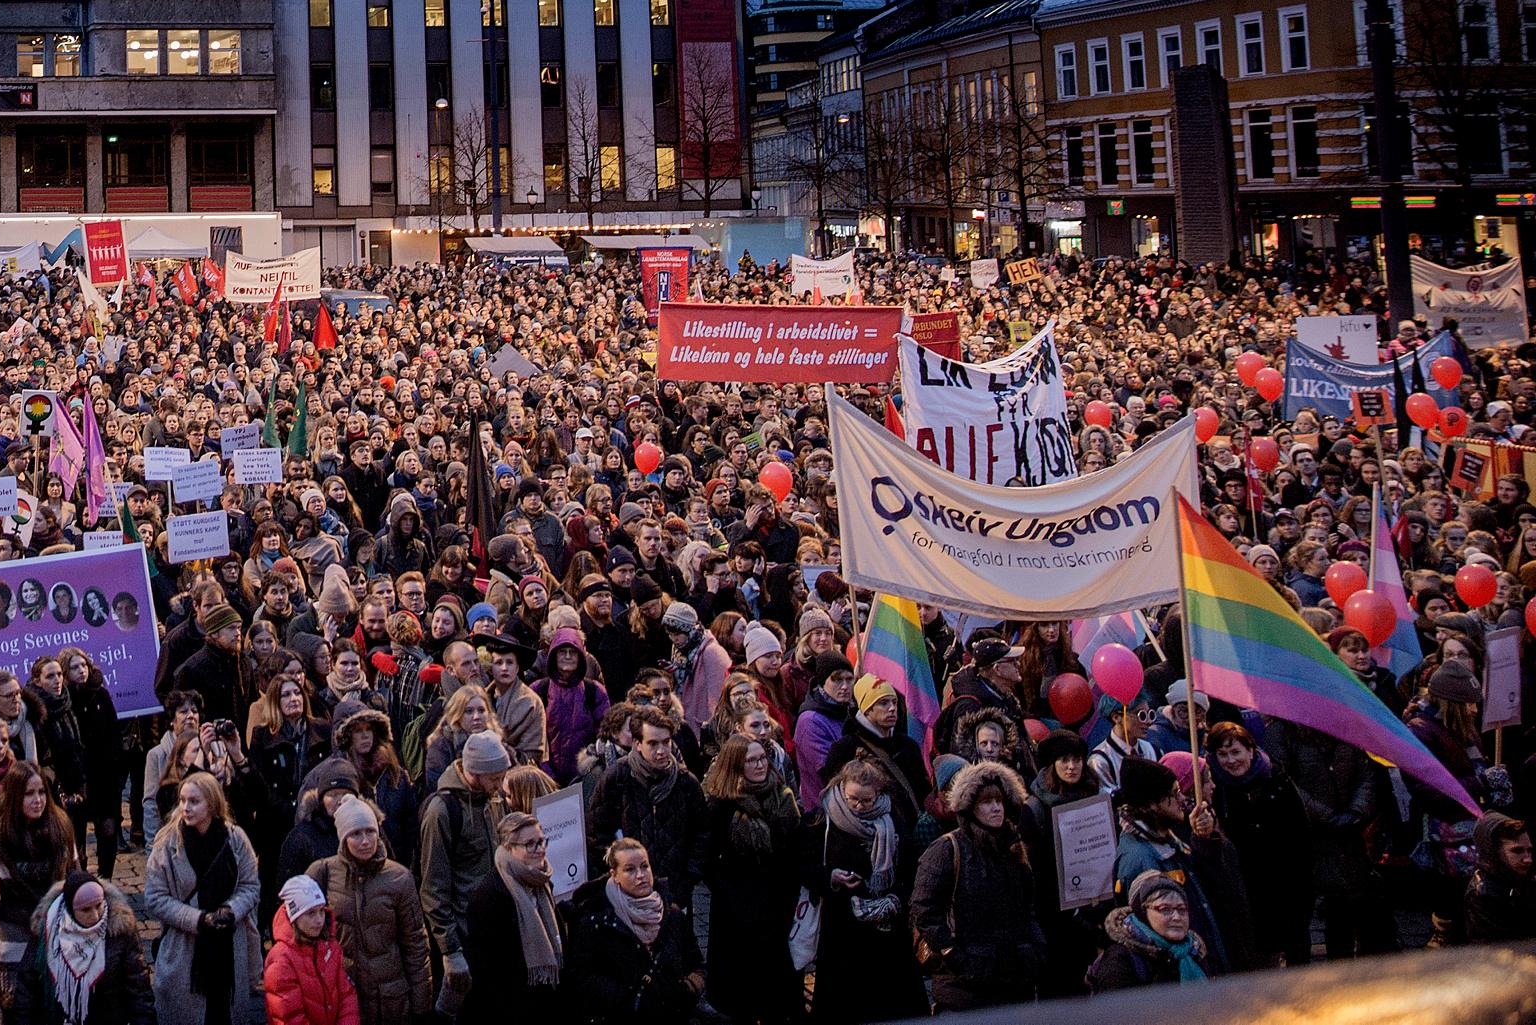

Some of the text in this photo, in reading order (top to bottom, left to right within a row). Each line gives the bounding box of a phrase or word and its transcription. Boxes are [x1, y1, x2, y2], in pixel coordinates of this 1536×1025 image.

[260, 271, 298, 283] NEI TIL
[1010, 257, 1041, 280] HEN
[659, 272, 668, 301] NTL
[682, 319, 762, 343] Likestilling
[766, 321, 774, 340] i
[776, 322, 858, 341] arbeidslivet
[670, 346, 888, 370] Likelønn og hele faste stillinger
[172, 516, 221, 528] STØTT KURDISKE
[914, 490, 1161, 548] Skeiv Ungdom
[174, 528, 203, 537] KVINNERS
[912, 531, 938, 550] for
[942, 541, 1003, 568] mangfold
[1018, 553, 1047, 568] mot
[1, 635, 21, 656] og
[24, 628, 89, 650] Sevenes
[99, 645, 133, 666] sjel,
